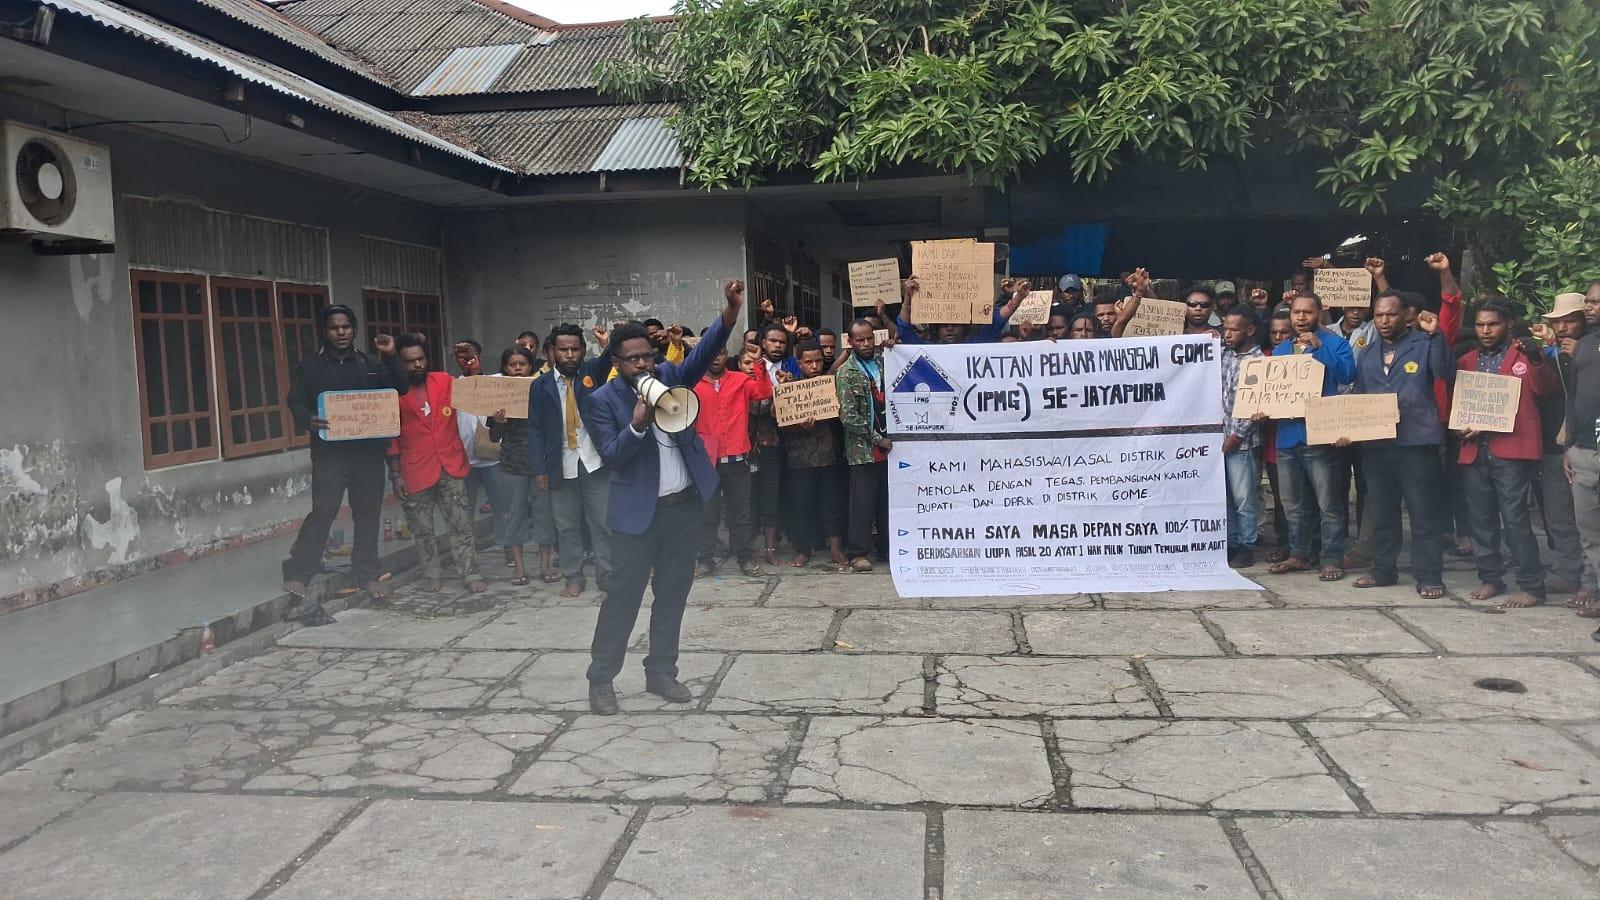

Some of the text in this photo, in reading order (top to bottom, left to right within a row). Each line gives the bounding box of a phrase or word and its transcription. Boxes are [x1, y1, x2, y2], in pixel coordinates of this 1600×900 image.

[966, 343, 1214, 379] IKATAN PELAJAR MAHASISWA GOME
[774, 385, 794, 398] KAMI
[963, 382, 1166, 422] (IPMG) SE-JAYAPURA
[929, 445, 1210, 474] KAMI MAHASISWA/I ASAL DISTRIK GOME
[918, 483, 976, 497] MENOLAK
[988, 478, 1032, 492] DENGAN
[1090, 473, 1161, 486] PEMBANGUNAN
[1164, 469, 1201, 481] KANTOR
[917, 502, 953, 513] BUPATI
[973, 499, 994, 509] DAN
[1004, 496, 1034, 508] DPRK
[1042, 493, 1051, 504] DI
[1057, 491, 1098, 502] DISTRIK
[917, 527, 975, 540] TANAH
[985, 525, 1021, 540] SAYA
[1032, 523, 1078, 540] MASA
[1083, 521, 1122, 538] DEPAN
[1125, 521, 1158, 536] SAYA
[1165, 519, 1188, 534] 100%
[917, 547, 981, 560] BERDASARKAN
[985, 547, 1011, 559] UUPA
[1015, 546, 1037, 558] PASAL
[1039, 545, 1051, 557] 20
[1054, 545, 1077, 557] AYAT
[1087, 545, 1102, 556] HAK
[1128, 543, 1152, 555] TURUN
[1207, 540, 1226, 551] ADAT
